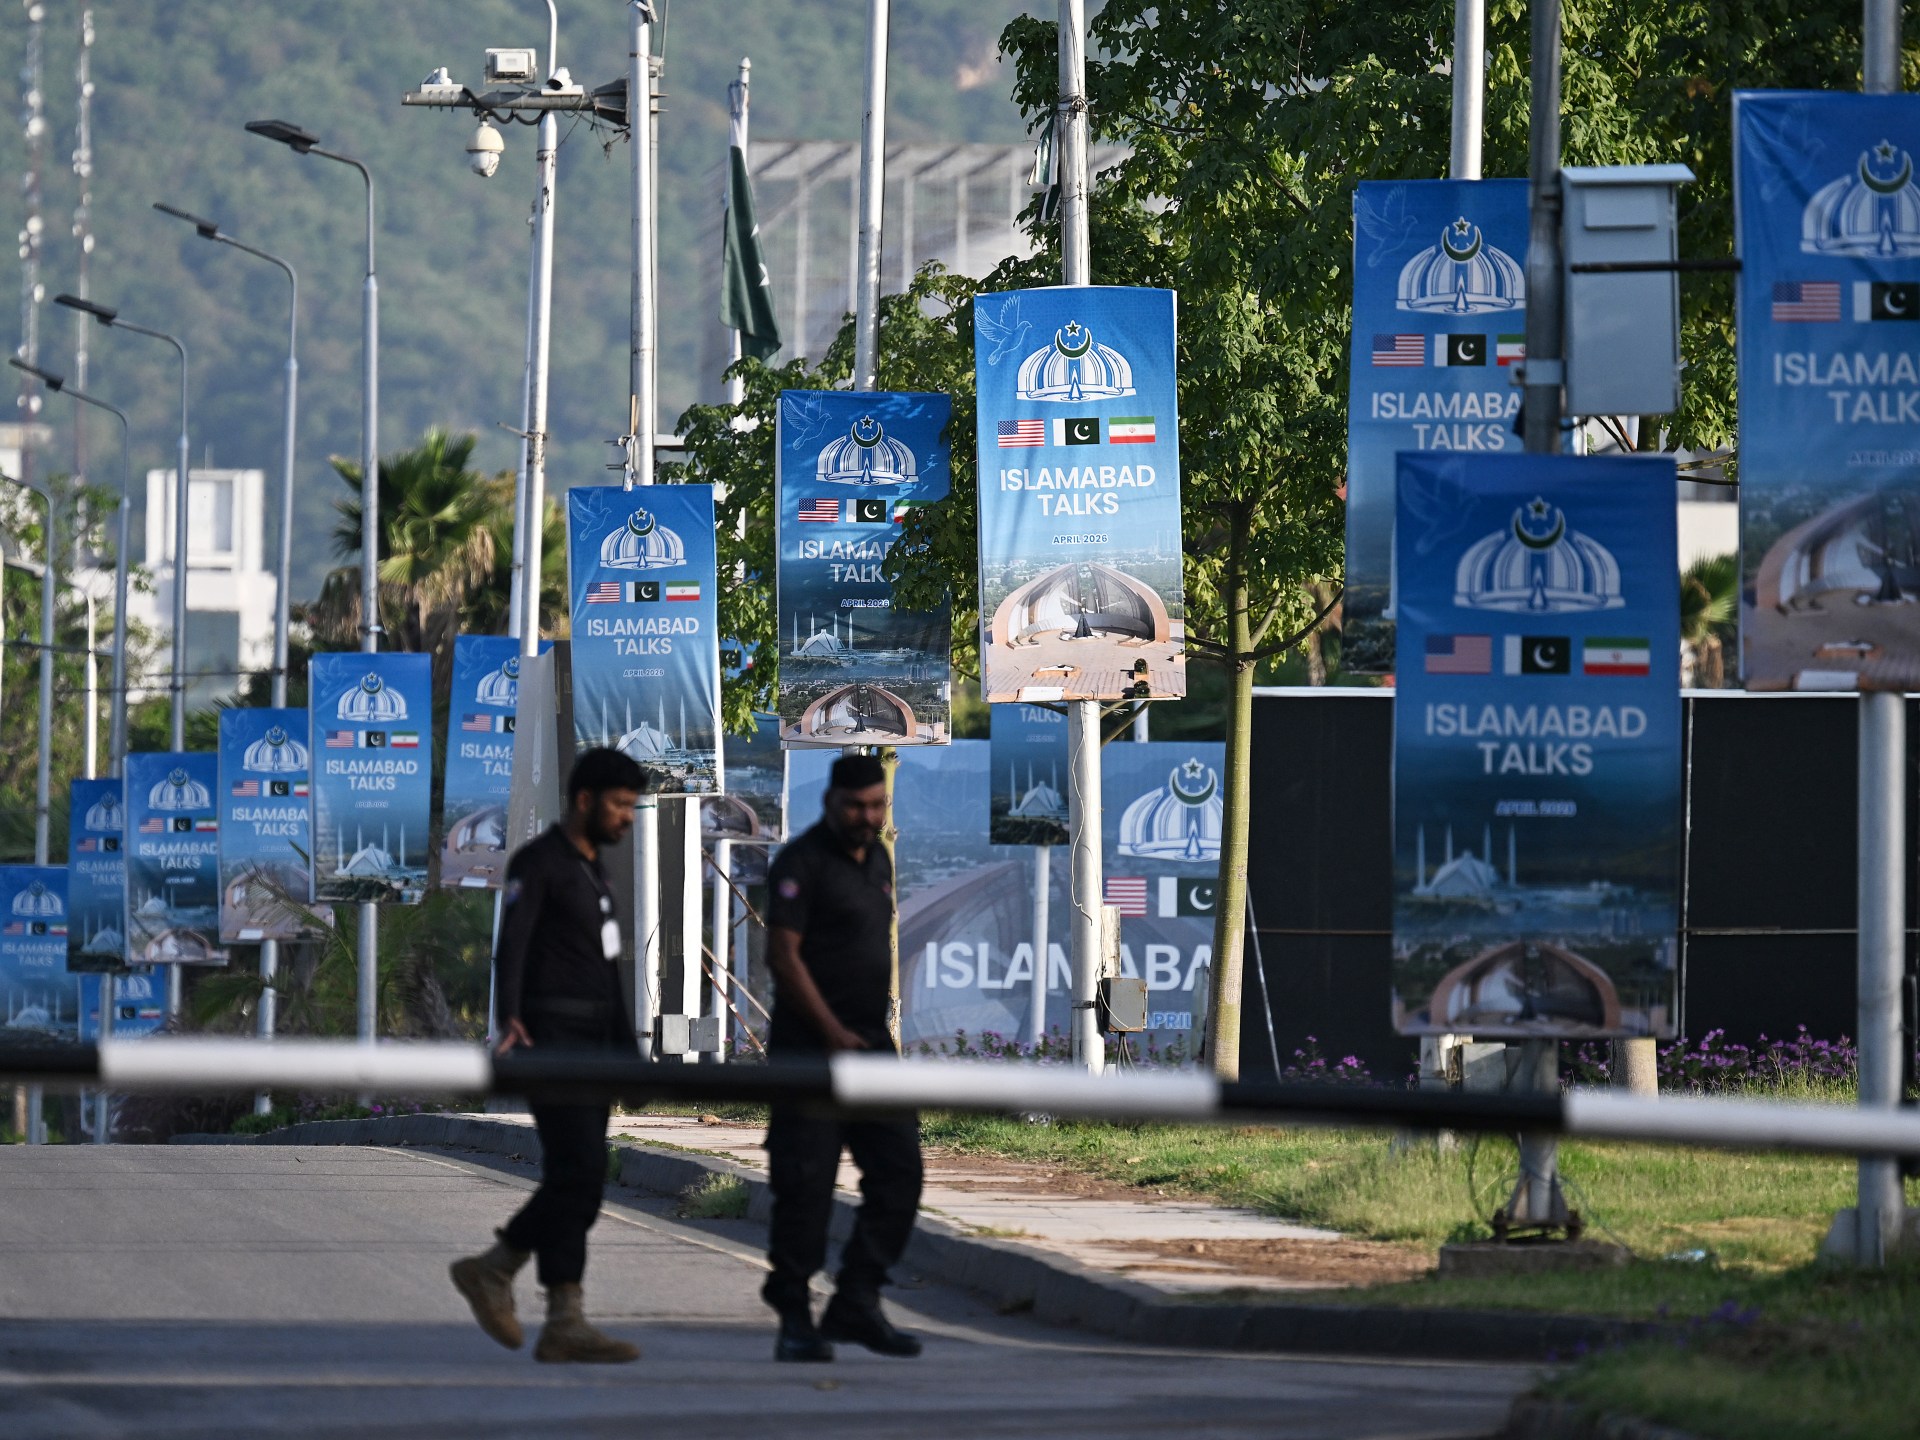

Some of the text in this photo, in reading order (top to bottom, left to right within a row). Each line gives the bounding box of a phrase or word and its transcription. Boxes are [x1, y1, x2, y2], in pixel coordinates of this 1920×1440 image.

[1774, 352, 1920, 386] ISLAMA
[1412, 423, 1505, 450] TALKS
[1000, 465, 1156, 491] ISLAMABAD
[1037, 492, 1119, 516] TALKS
[1052, 534, 1108, 545] APRIL 2026
[798, 539, 930, 560] ISLAMA
[840, 599, 890, 608] APRIL 2026
[587, 617, 699, 637] ISLAMABAD
[614, 637, 673, 656] TALKS
[622, 668, 645, 678] APRIL
[1019, 707, 1062, 723] TALKS
[1424, 703, 1648, 738] ISLAMABAD
[460, 743, 513, 760] ISLAM
[1477, 741, 1594, 776] TALKS
[326, 759, 418, 775] ISLAMABAD
[348, 776, 396, 791] TALKS
[232, 807, 309, 822] ISLAMABA
[253, 822, 299, 836] TALKS
[159, 856, 201, 869] TALKS
